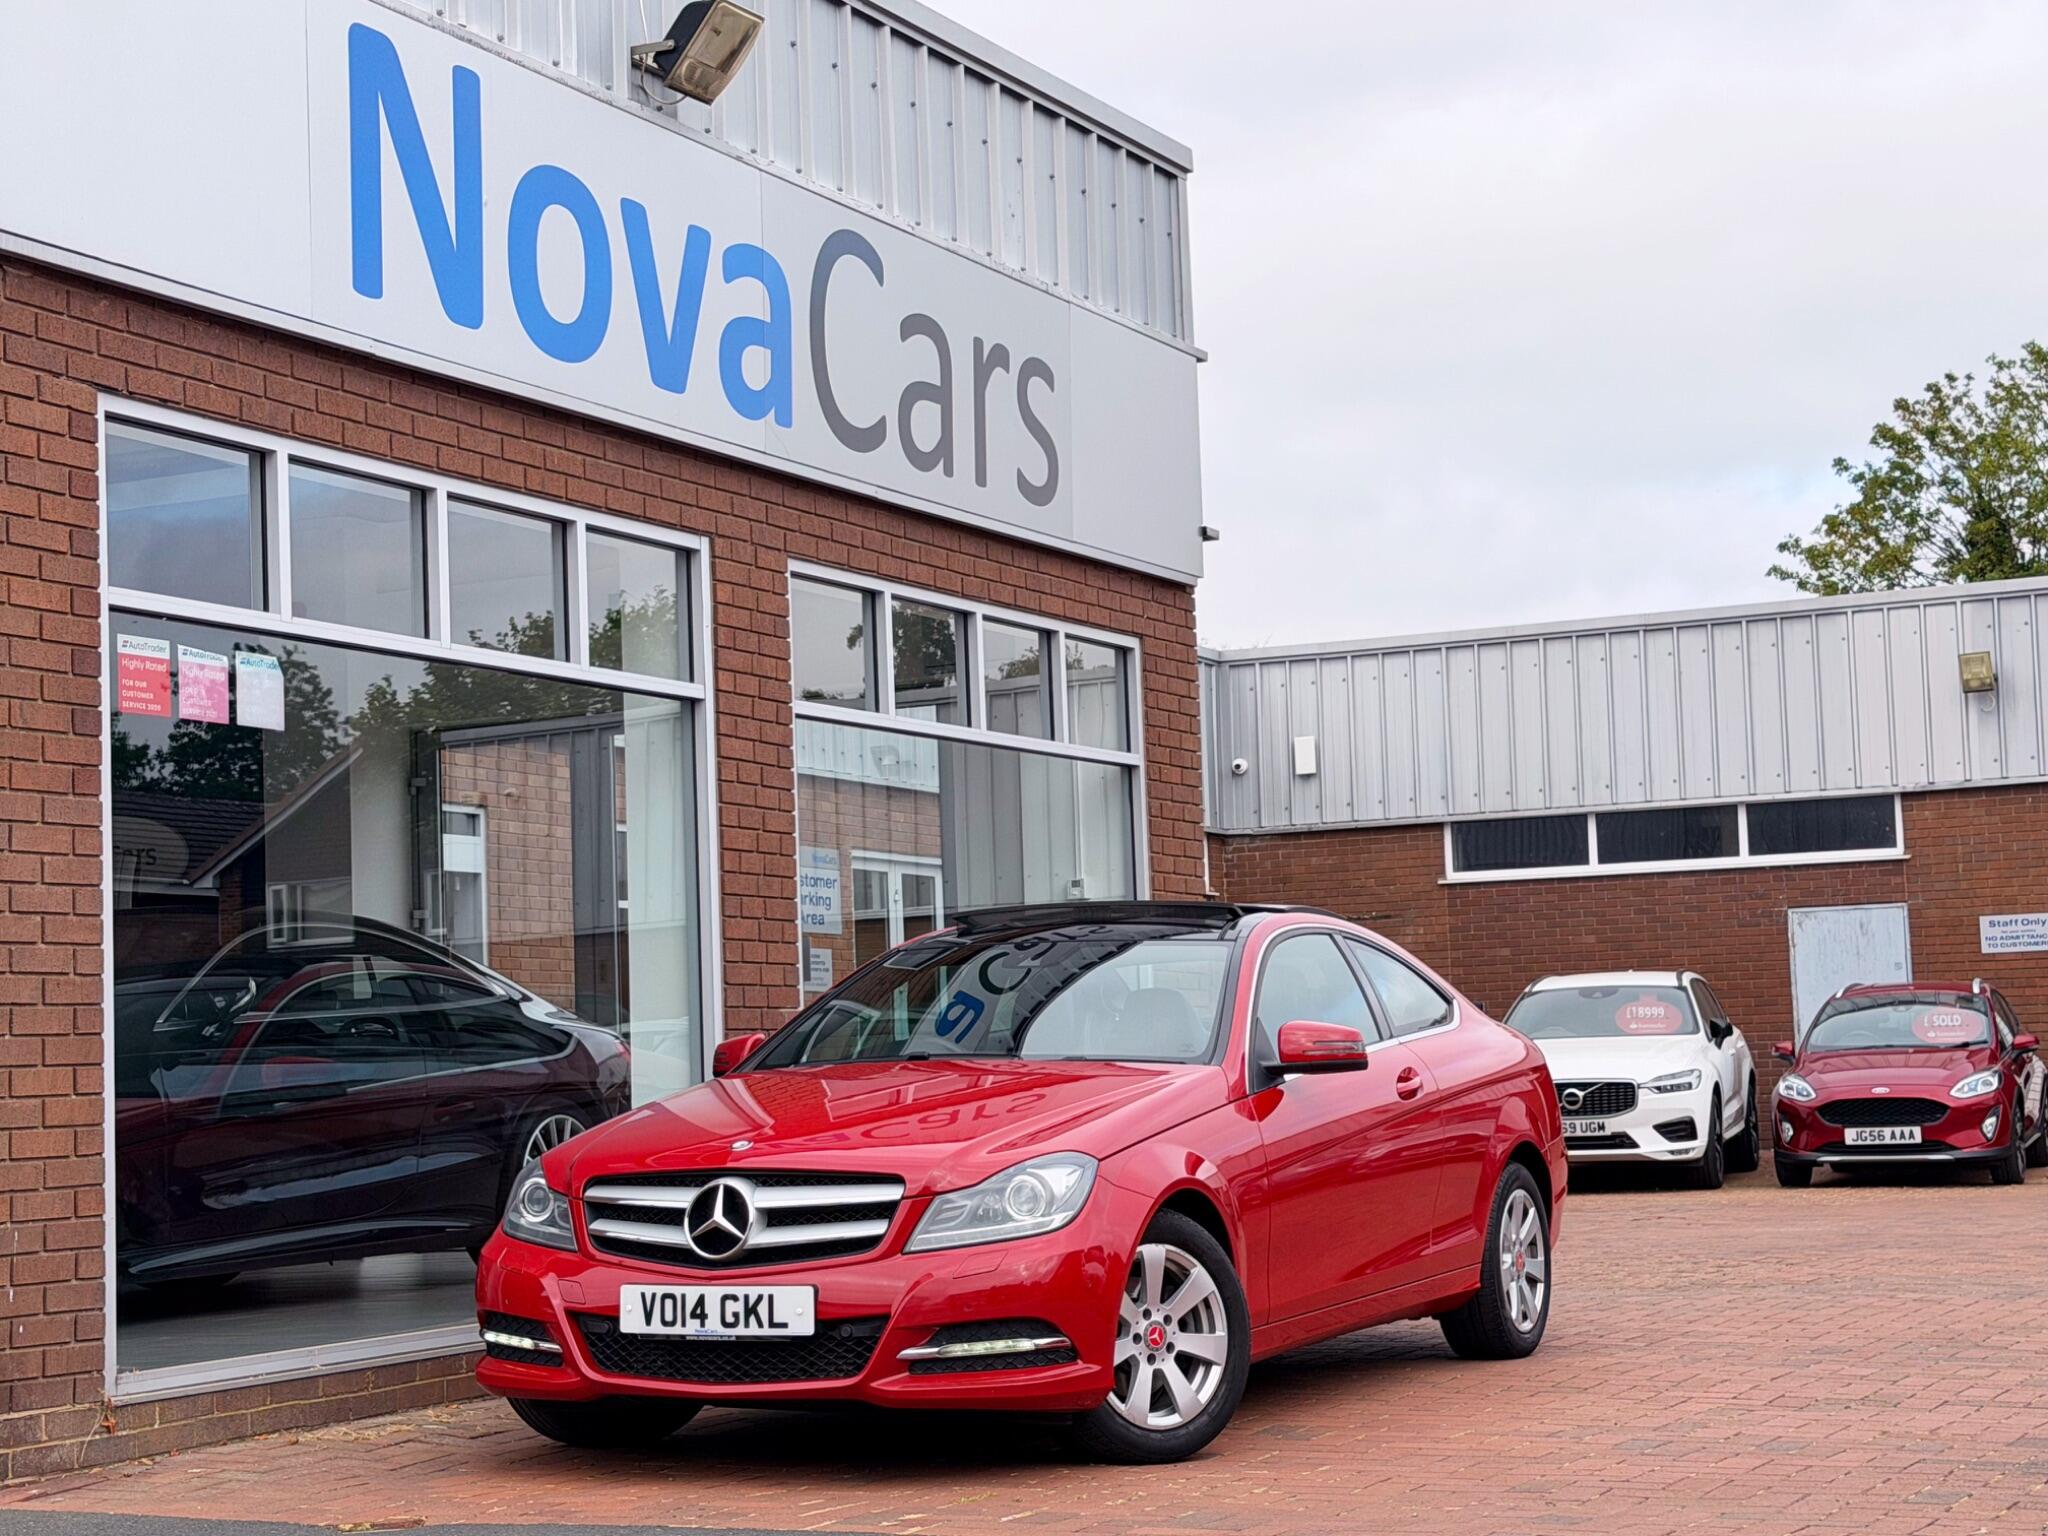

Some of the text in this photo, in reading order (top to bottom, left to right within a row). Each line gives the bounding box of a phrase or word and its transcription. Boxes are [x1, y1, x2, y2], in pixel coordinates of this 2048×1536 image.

[347, 22, 1059, 507] NovaCars
[122, 657, 167, 673] Highly Rated
[122, 690, 154, 699] CUSTOMER
[1989, 918, 2047, 928] Staff Only
[1932, 1014, 1962, 1026] SOLD
[1580, 1121, 1606, 1133] UGM
[1851, 1128, 1916, 1142] JG56 AAA
[640, 1291, 789, 1329] VO14 GKL
